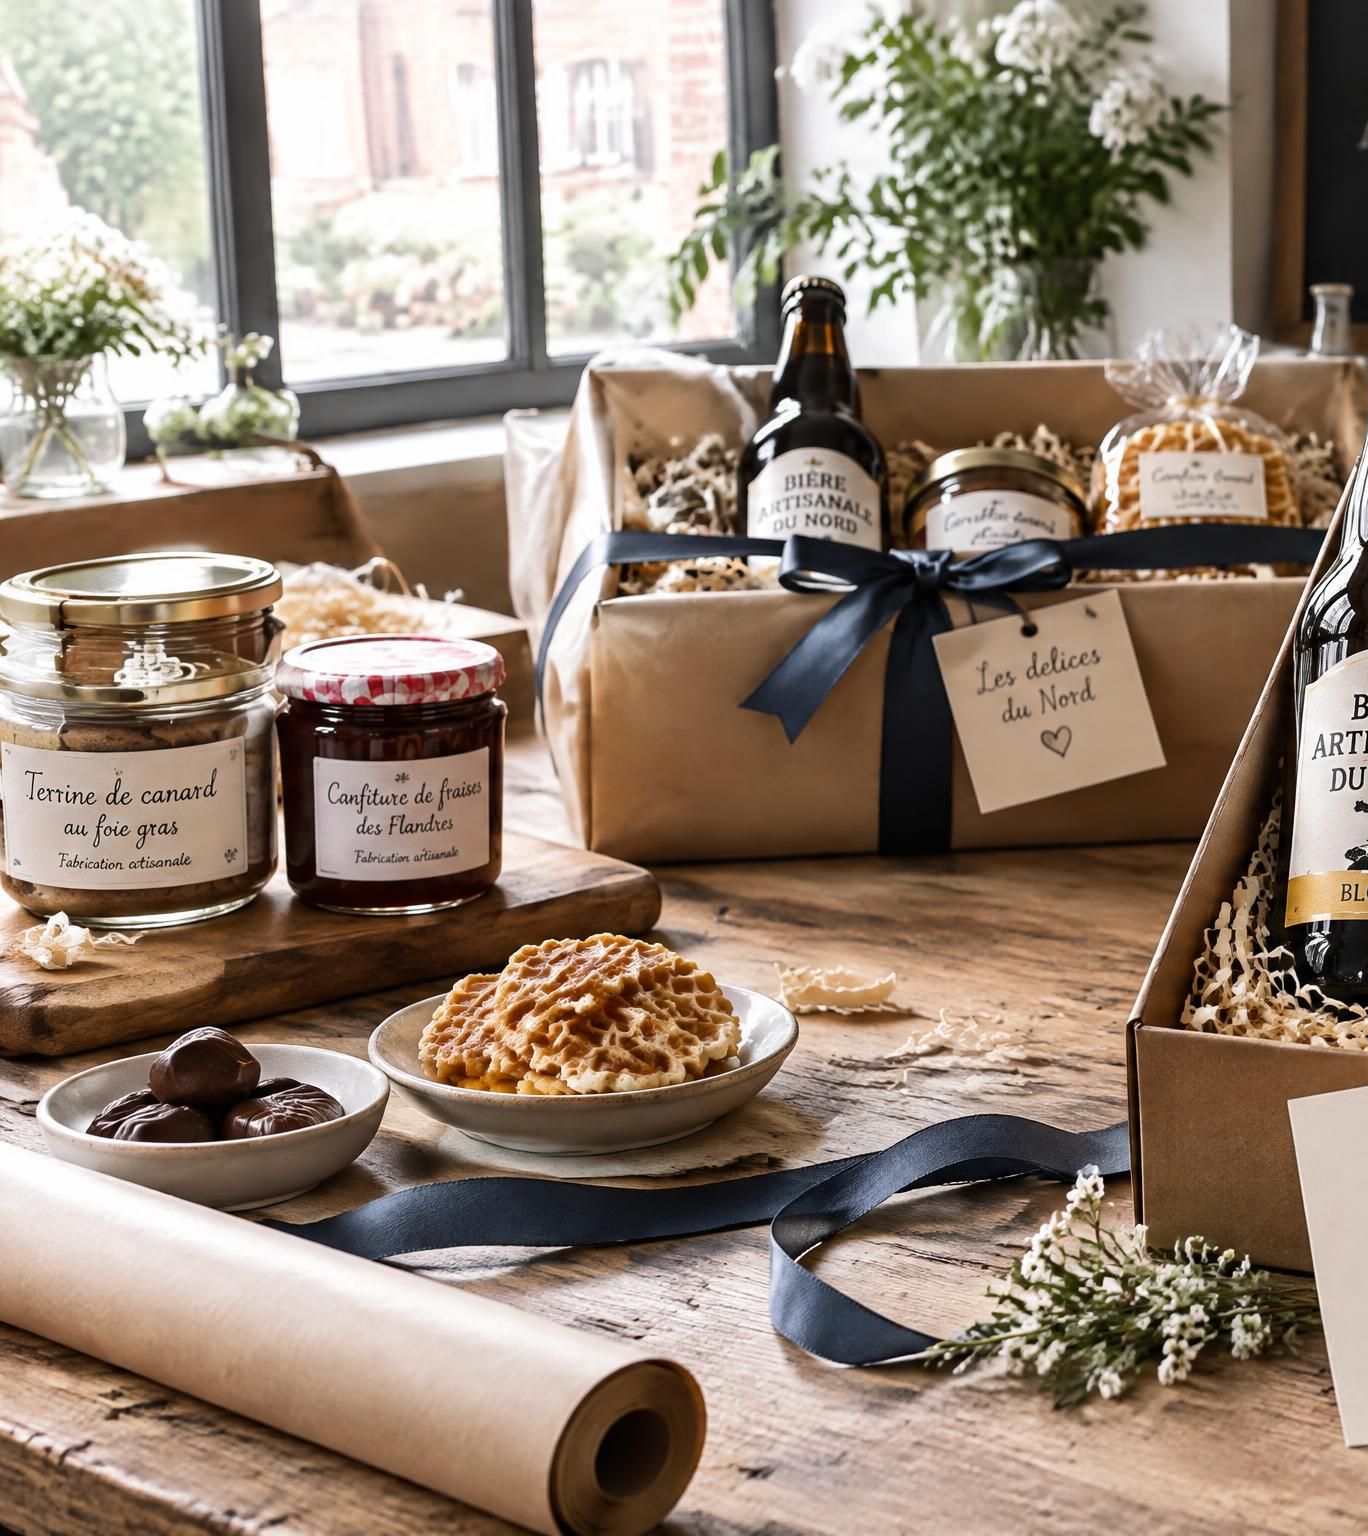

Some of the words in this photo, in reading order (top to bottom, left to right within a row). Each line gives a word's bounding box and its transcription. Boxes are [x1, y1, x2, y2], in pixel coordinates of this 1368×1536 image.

[784, 468, 848, 493] BIÈRE
[757, 493, 873, 527] ARTISANALE
[773, 516, 798, 533] DU
[804, 512, 857, 535] NORD
[975, 660, 1017, 696] Les
[1002, 697, 1032, 723] du
[1038, 675, 1096, 715] Nord
[24, 769, 97, 806] Terrine
[105, 777, 133, 806] de
[141, 768, 218, 804] canard
[414, 782, 433, 805] de
[437, 777, 483, 811] fraises
[1329, 766, 1368, 793] DU
[63, 822, 88, 837] au
[92, 814, 131, 848] foie
[135, 820, 179, 850] gras
[356, 816, 383, 836] des
[387, 813, 454, 836] Flandres
[58, 852, 124, 871] Fabrication
[354, 850, 410, 865] Fabrication
